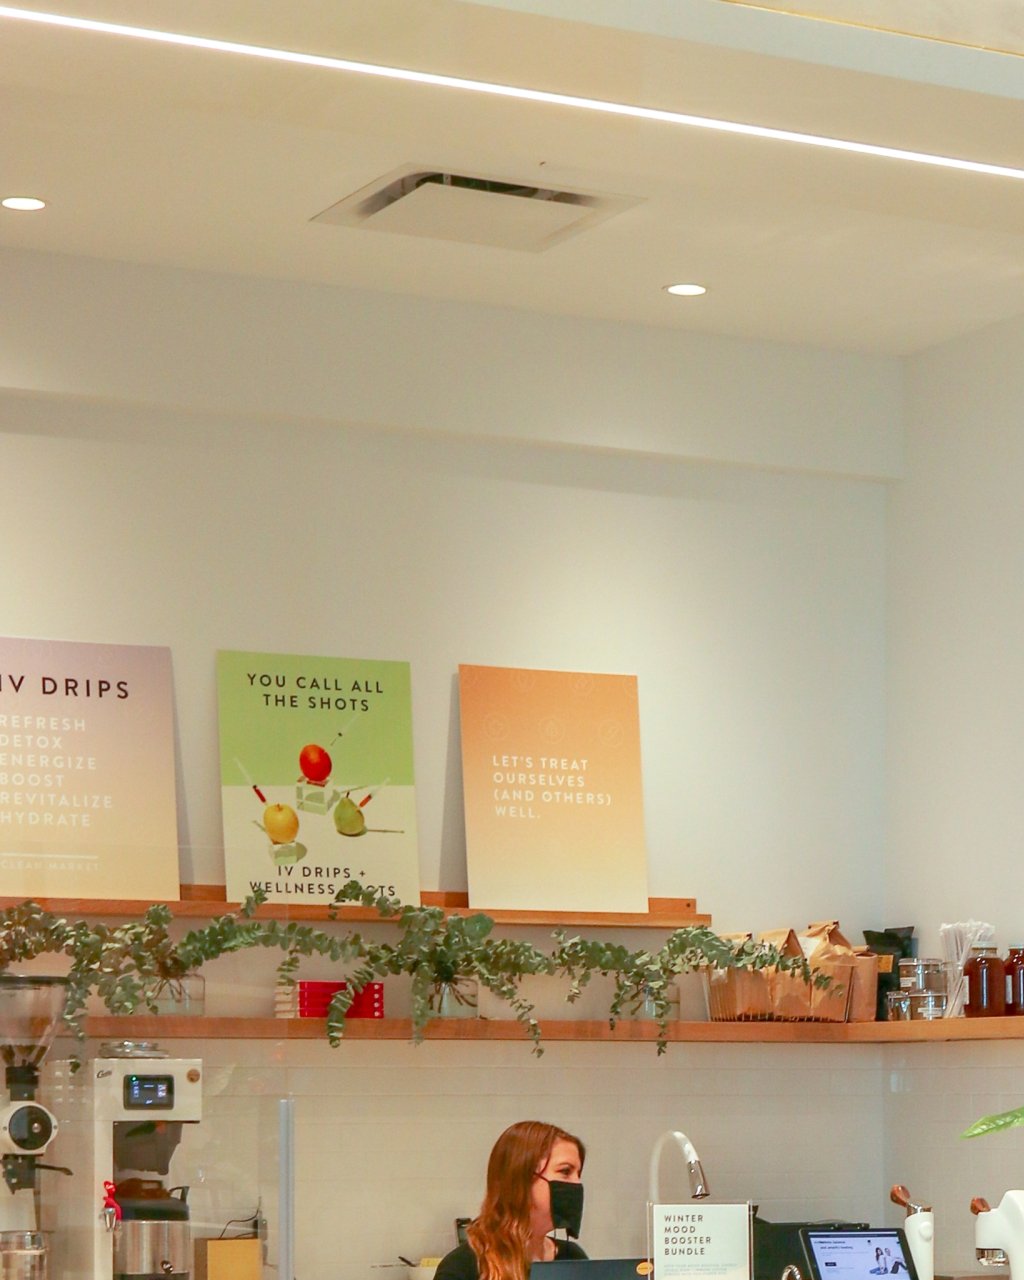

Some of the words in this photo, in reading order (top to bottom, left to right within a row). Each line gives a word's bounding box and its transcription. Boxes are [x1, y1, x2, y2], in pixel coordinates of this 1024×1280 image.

[42, 677, 129, 699] DRIPS
[247, 673, 286, 688] YOU
[296, 676, 342, 691] CALL
[351, 680, 384, 694] ALL
[263, 694, 298, 708] THE
[308, 696, 369, 711] SHOTS
[0, 714, 86, 731] REFRESH
[0, 734, 63, 749] DETOX
[0, 753, 97, 770] ENERGIZE
[492, 755, 534, 769] LET'S
[540, 757, 589, 771] TREAT
[0, 772, 65, 788] BOOST
[493, 772, 585, 788] OURSELVES
[0, 791, 113, 809] REVITALIZE
[494, 788, 535, 802] (AND
[542, 791, 612, 806] OTHERS)
[0, 811, 91, 827] HYDRATE
[495, 806, 541, 819] WELL.
[277, 865, 293, 877] IV
[302, 866, 351, 878] DRIPS
[250, 881, 336, 895] WELLNESS
[664, 1214, 704, 1222] WINTER
[664, 1225, 696, 1233] MOOD
[664, 1236, 712, 1244] BOOSTER
[664, 1247, 705, 1255] BUNDLE
